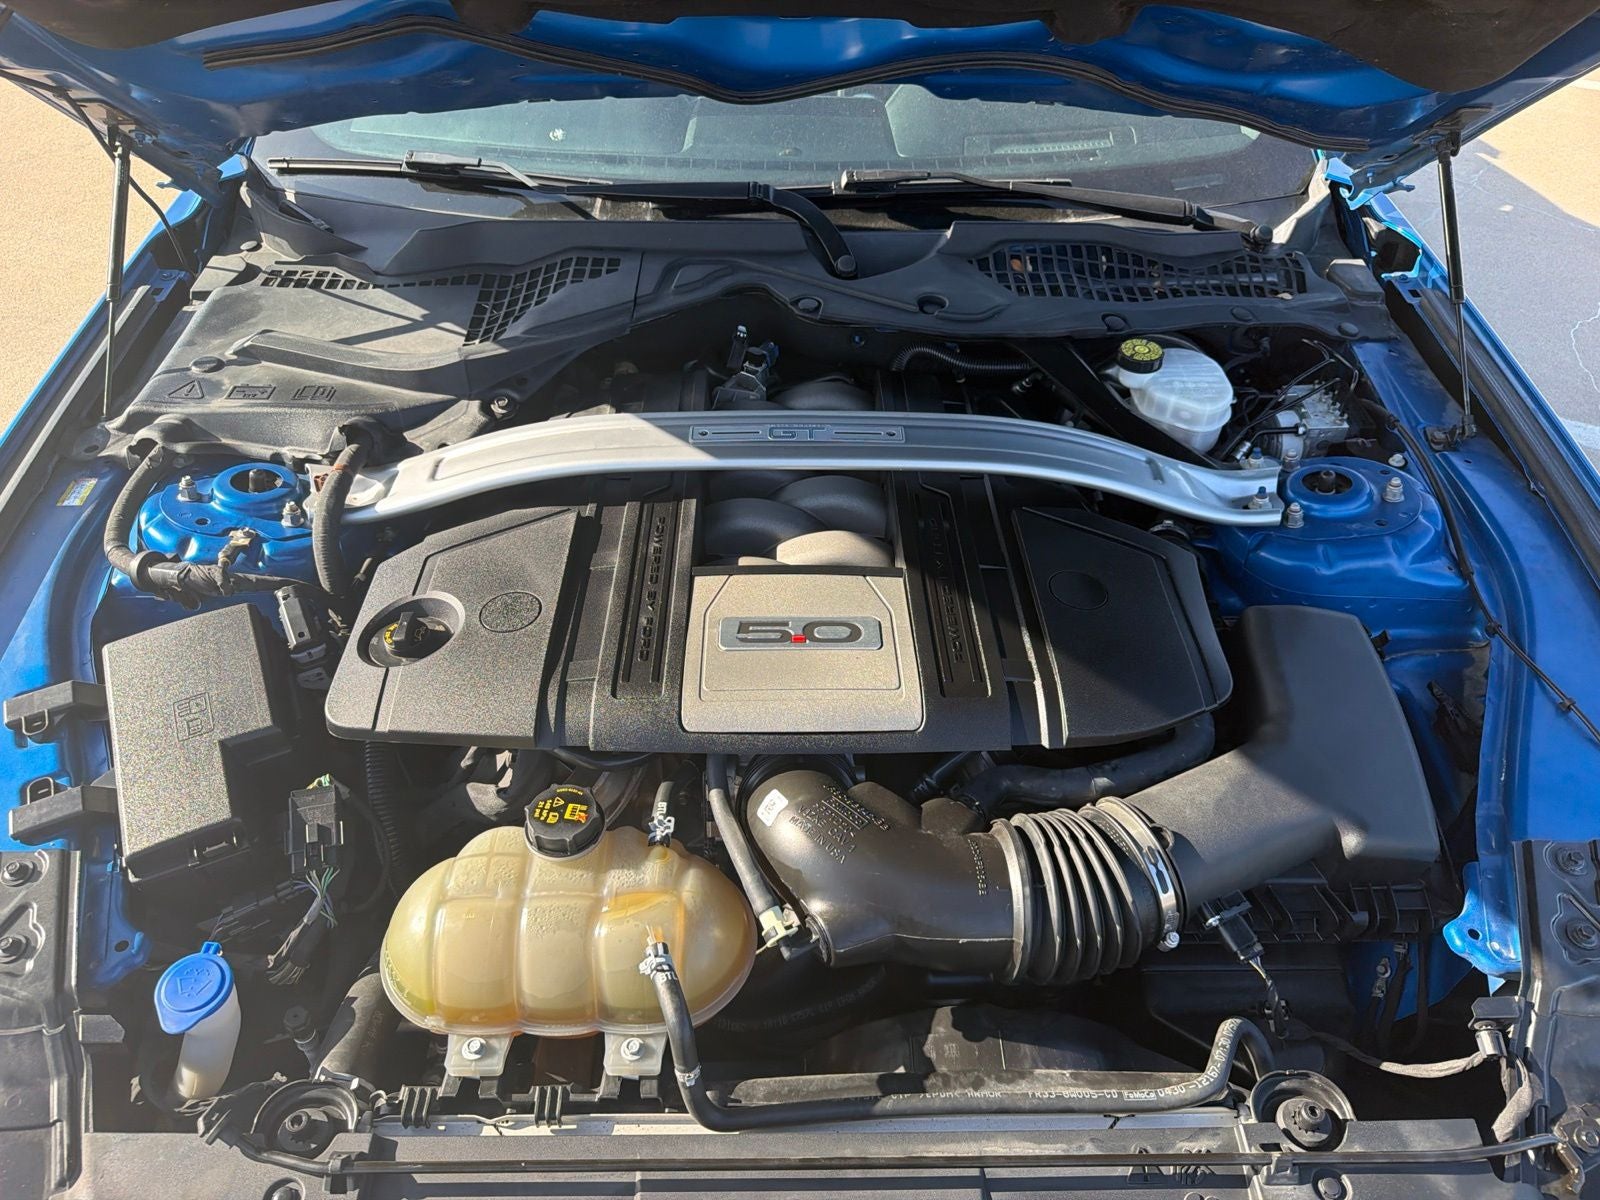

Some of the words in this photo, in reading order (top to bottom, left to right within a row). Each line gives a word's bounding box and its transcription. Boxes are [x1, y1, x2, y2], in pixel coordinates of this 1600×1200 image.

[767, 425, 827, 440] GT
[648, 516, 666, 584] POWERED
[646, 589, 657, 611] BY
[637, 616, 653, 662] FORD
[736, 620, 863, 643] 5.0
